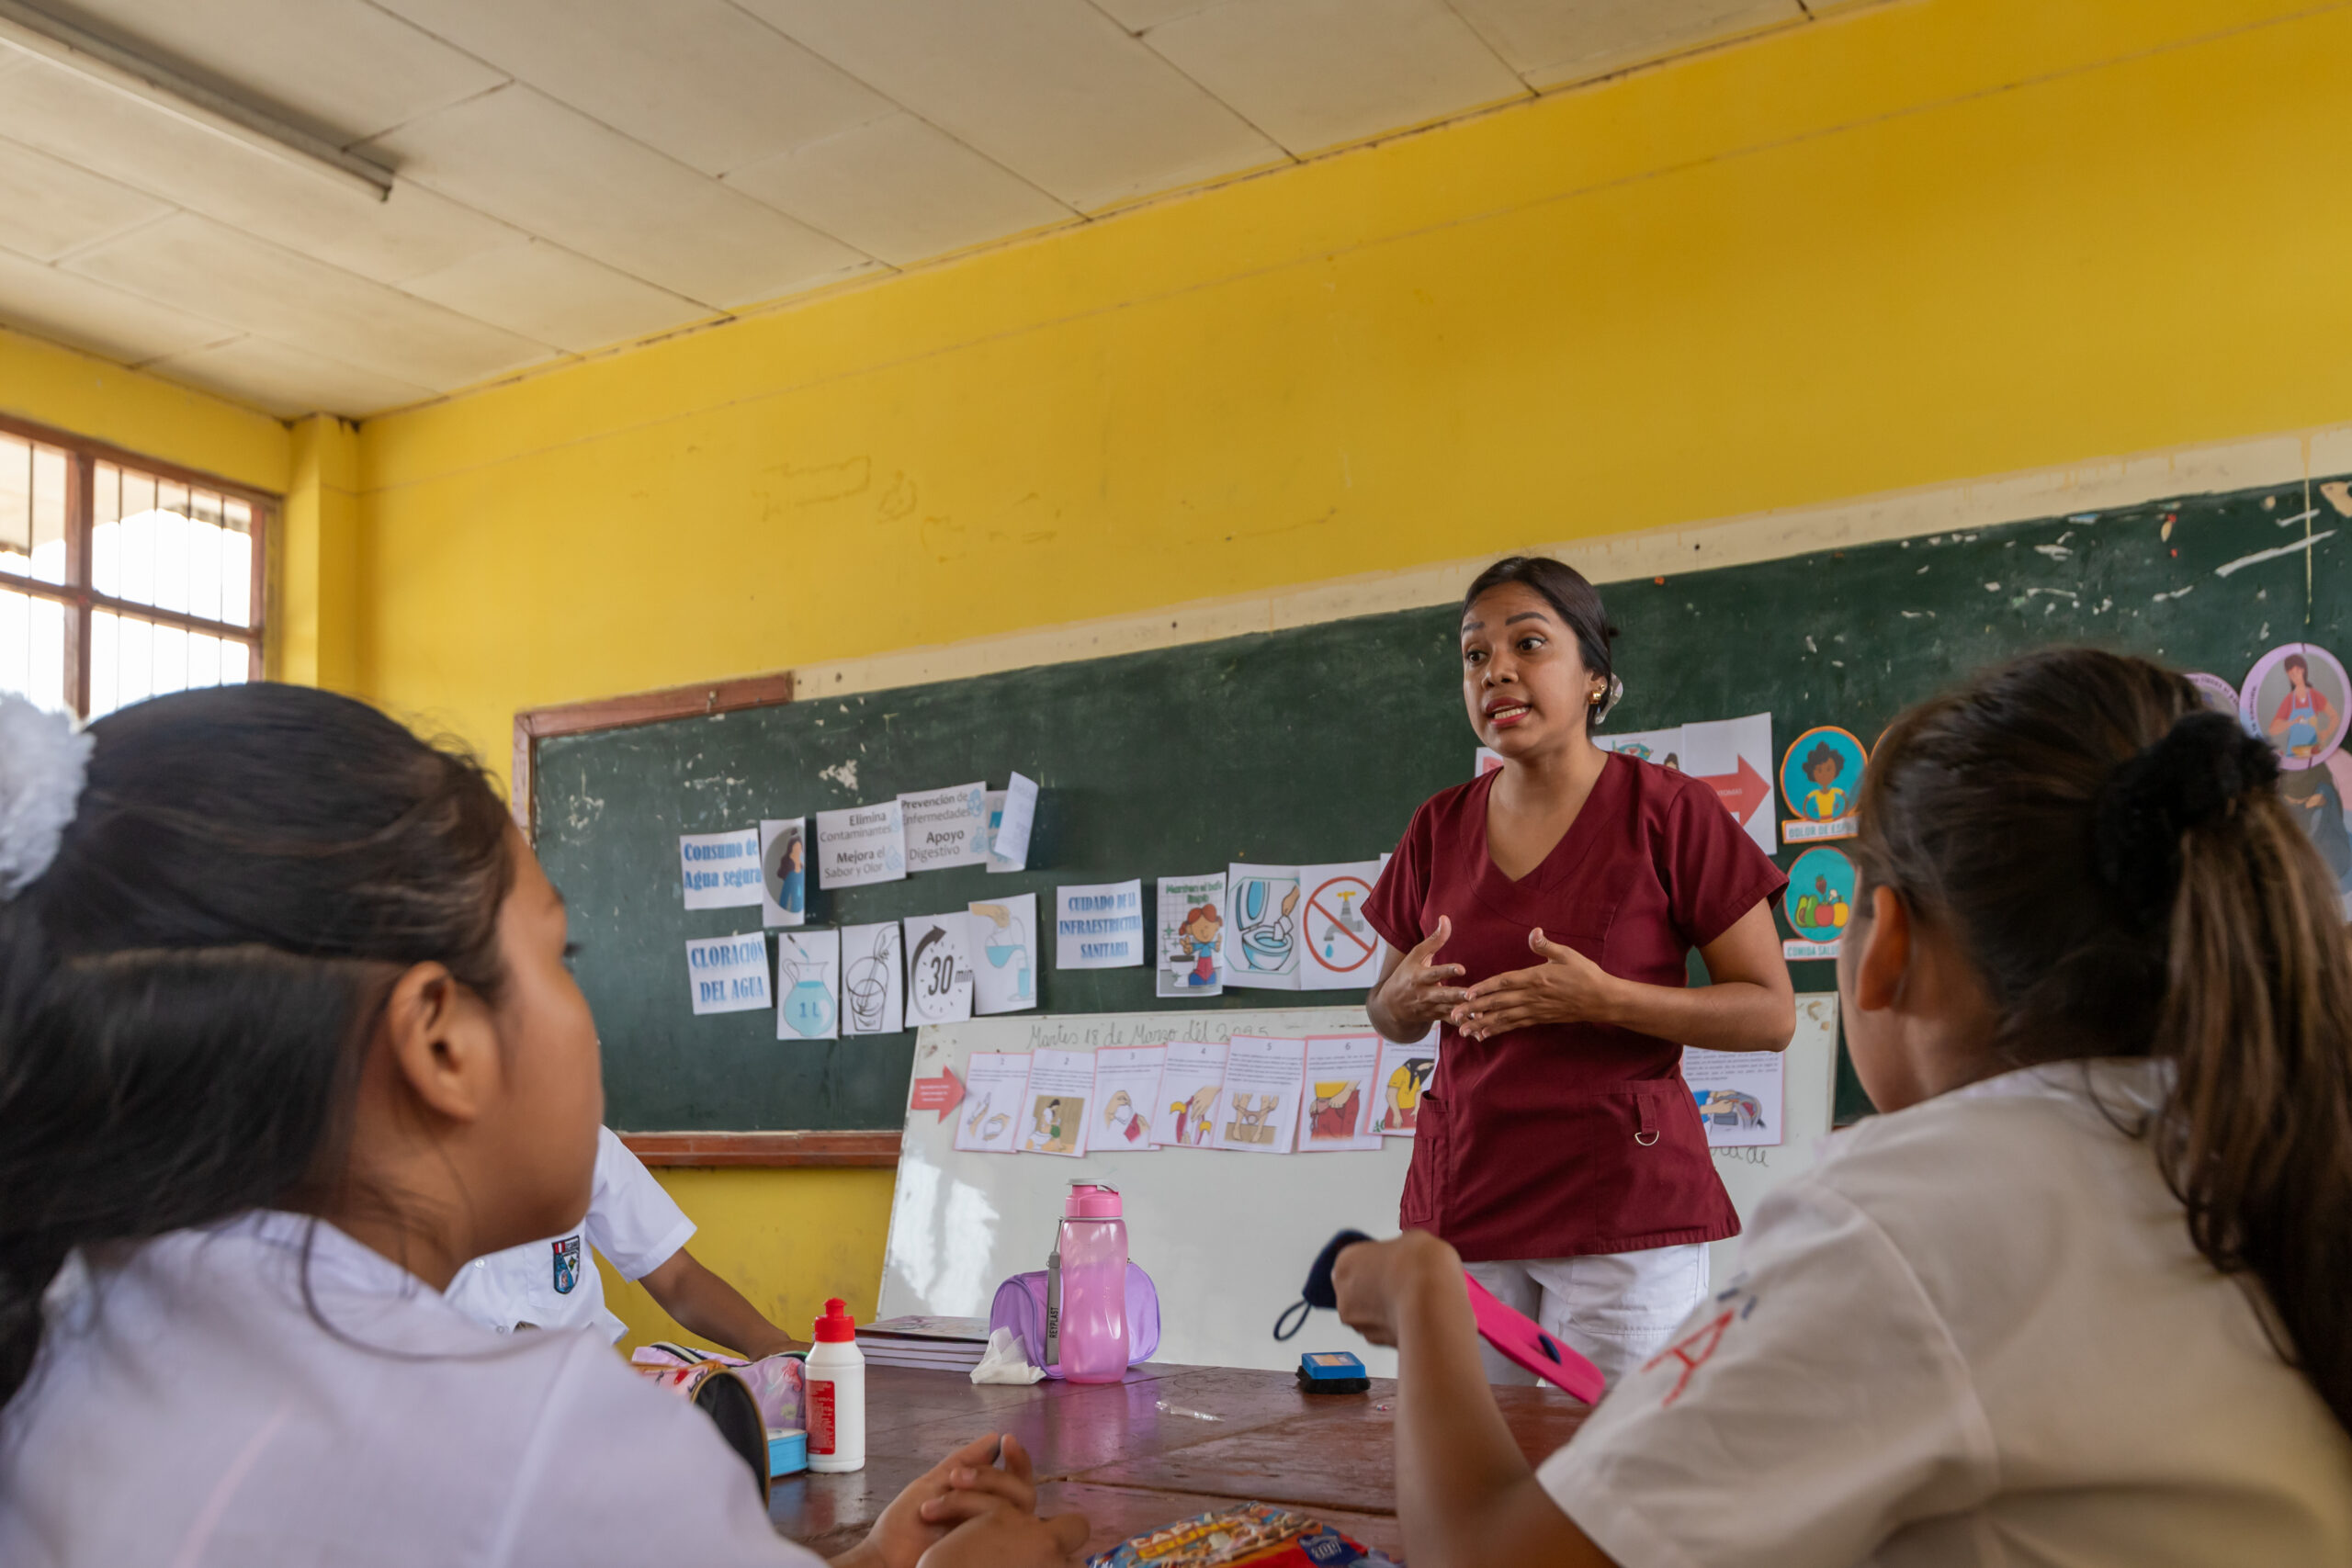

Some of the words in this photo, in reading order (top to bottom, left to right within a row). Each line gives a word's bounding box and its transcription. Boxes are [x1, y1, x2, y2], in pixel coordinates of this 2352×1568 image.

[956, 791, 968, 802] de
[849, 812, 887, 827] Elimina
[820, 825, 892, 843] Contaminantes
[926, 829, 965, 845] Apoyo
[684, 841, 743, 862] Consumo
[836, 849, 875, 864] Mejora
[876, 845, 886, 859] el
[909, 845, 961, 863] Digestivo
[683, 871, 719, 892] Agua
[722, 866, 762, 888] segura
[824, 865, 854, 879] Sabor
[855, 866, 861, 877] y
[864, 862, 883, 874] Olor
[1069, 895, 1114, 911] CUIDADO
[691, 938, 765, 969] CLORACIÓN
[928, 954, 954, 996] 30
[699, 979, 726, 1002] DEL
[731, 975, 764, 999] AGUA
[1102, 1021, 1124, 1046] de
[1049, 1306, 1059, 1338] REYPLAST
